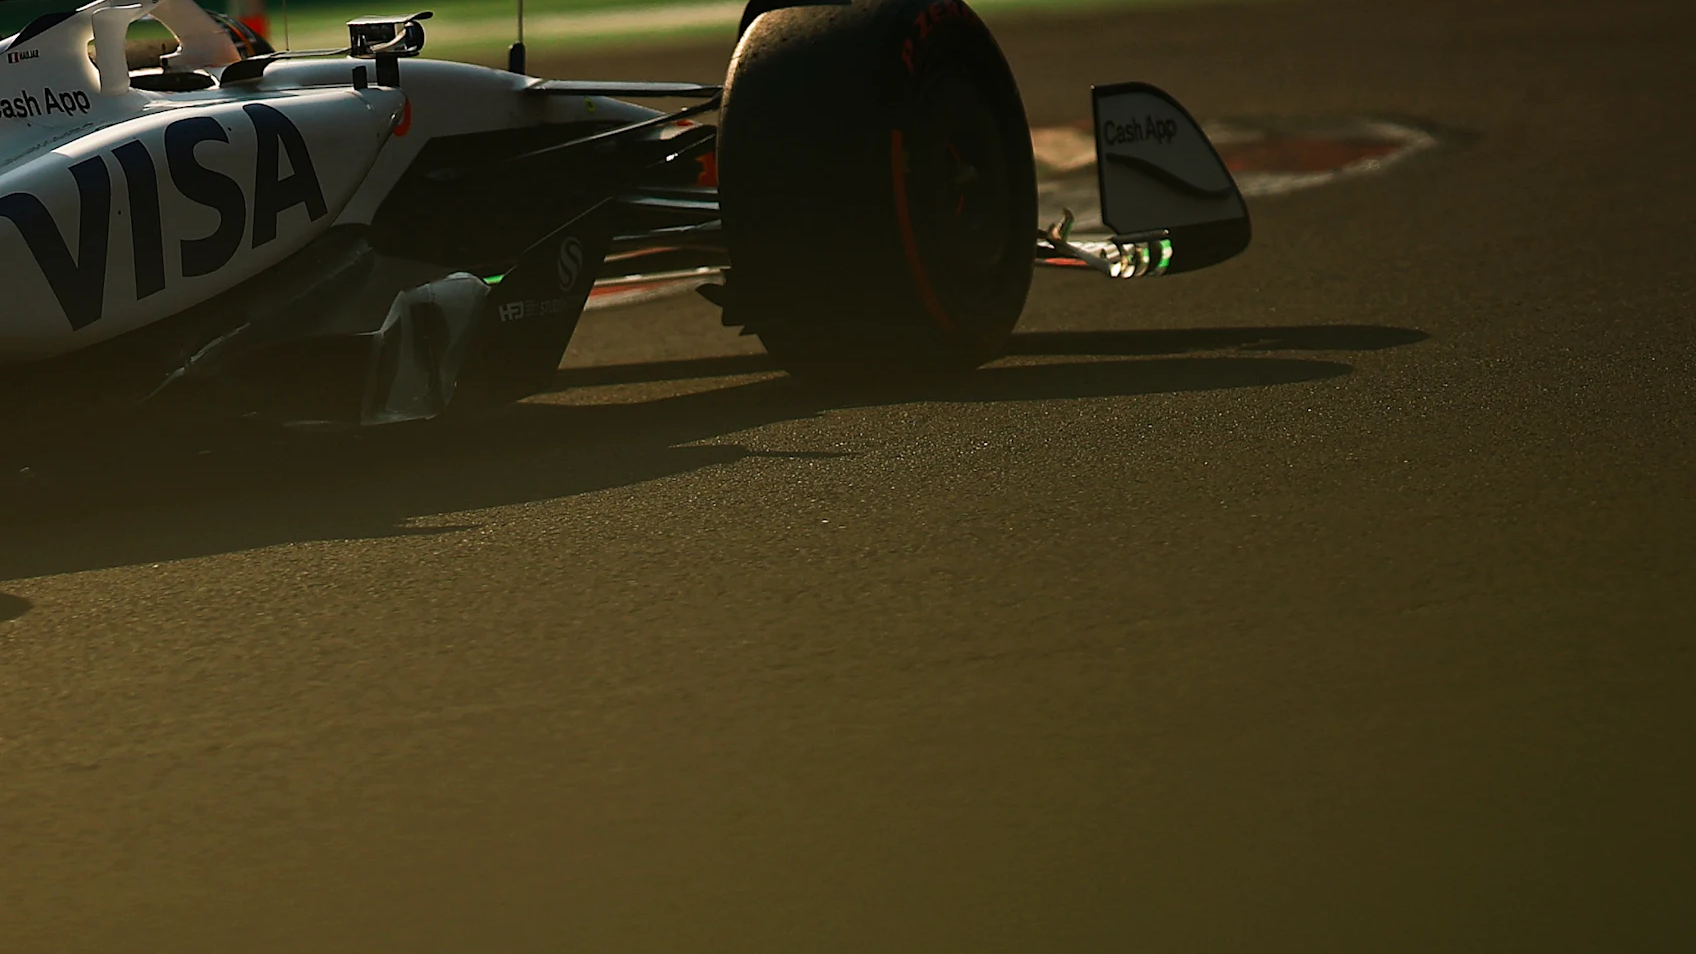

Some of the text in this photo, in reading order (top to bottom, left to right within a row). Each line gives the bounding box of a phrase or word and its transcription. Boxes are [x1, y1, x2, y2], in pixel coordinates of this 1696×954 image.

[44, 87, 91, 117] App
[1104, 114, 1178, 145] Cash App
